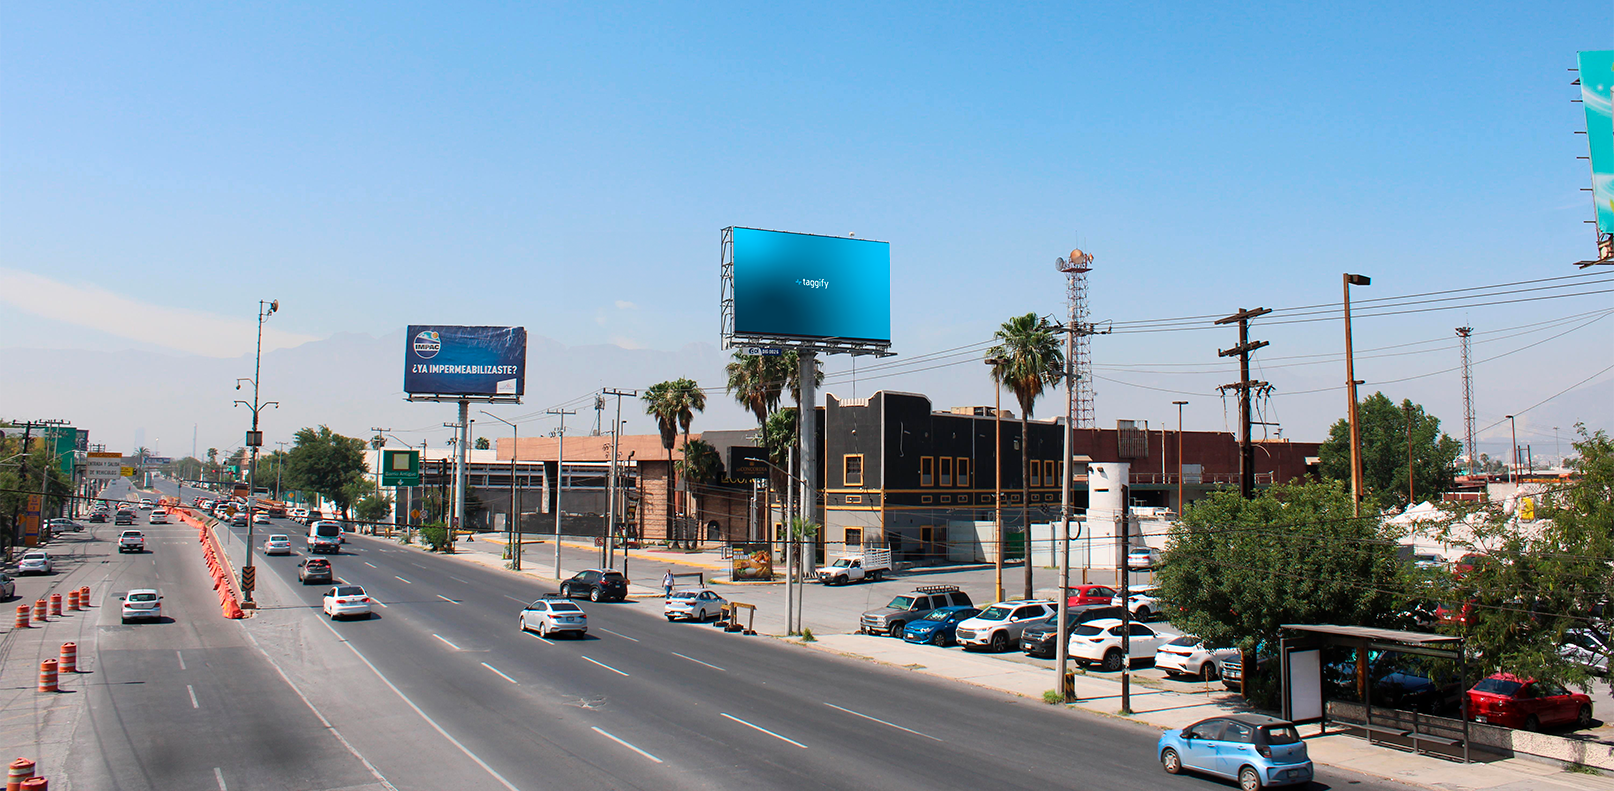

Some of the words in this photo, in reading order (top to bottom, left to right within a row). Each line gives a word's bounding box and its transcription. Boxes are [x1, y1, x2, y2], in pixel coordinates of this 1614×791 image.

[802, 278, 829, 289] taggify
[412, 364, 428, 374] ¿YA
[429, 364, 518, 375] IMPERMEABILIZASTE?
